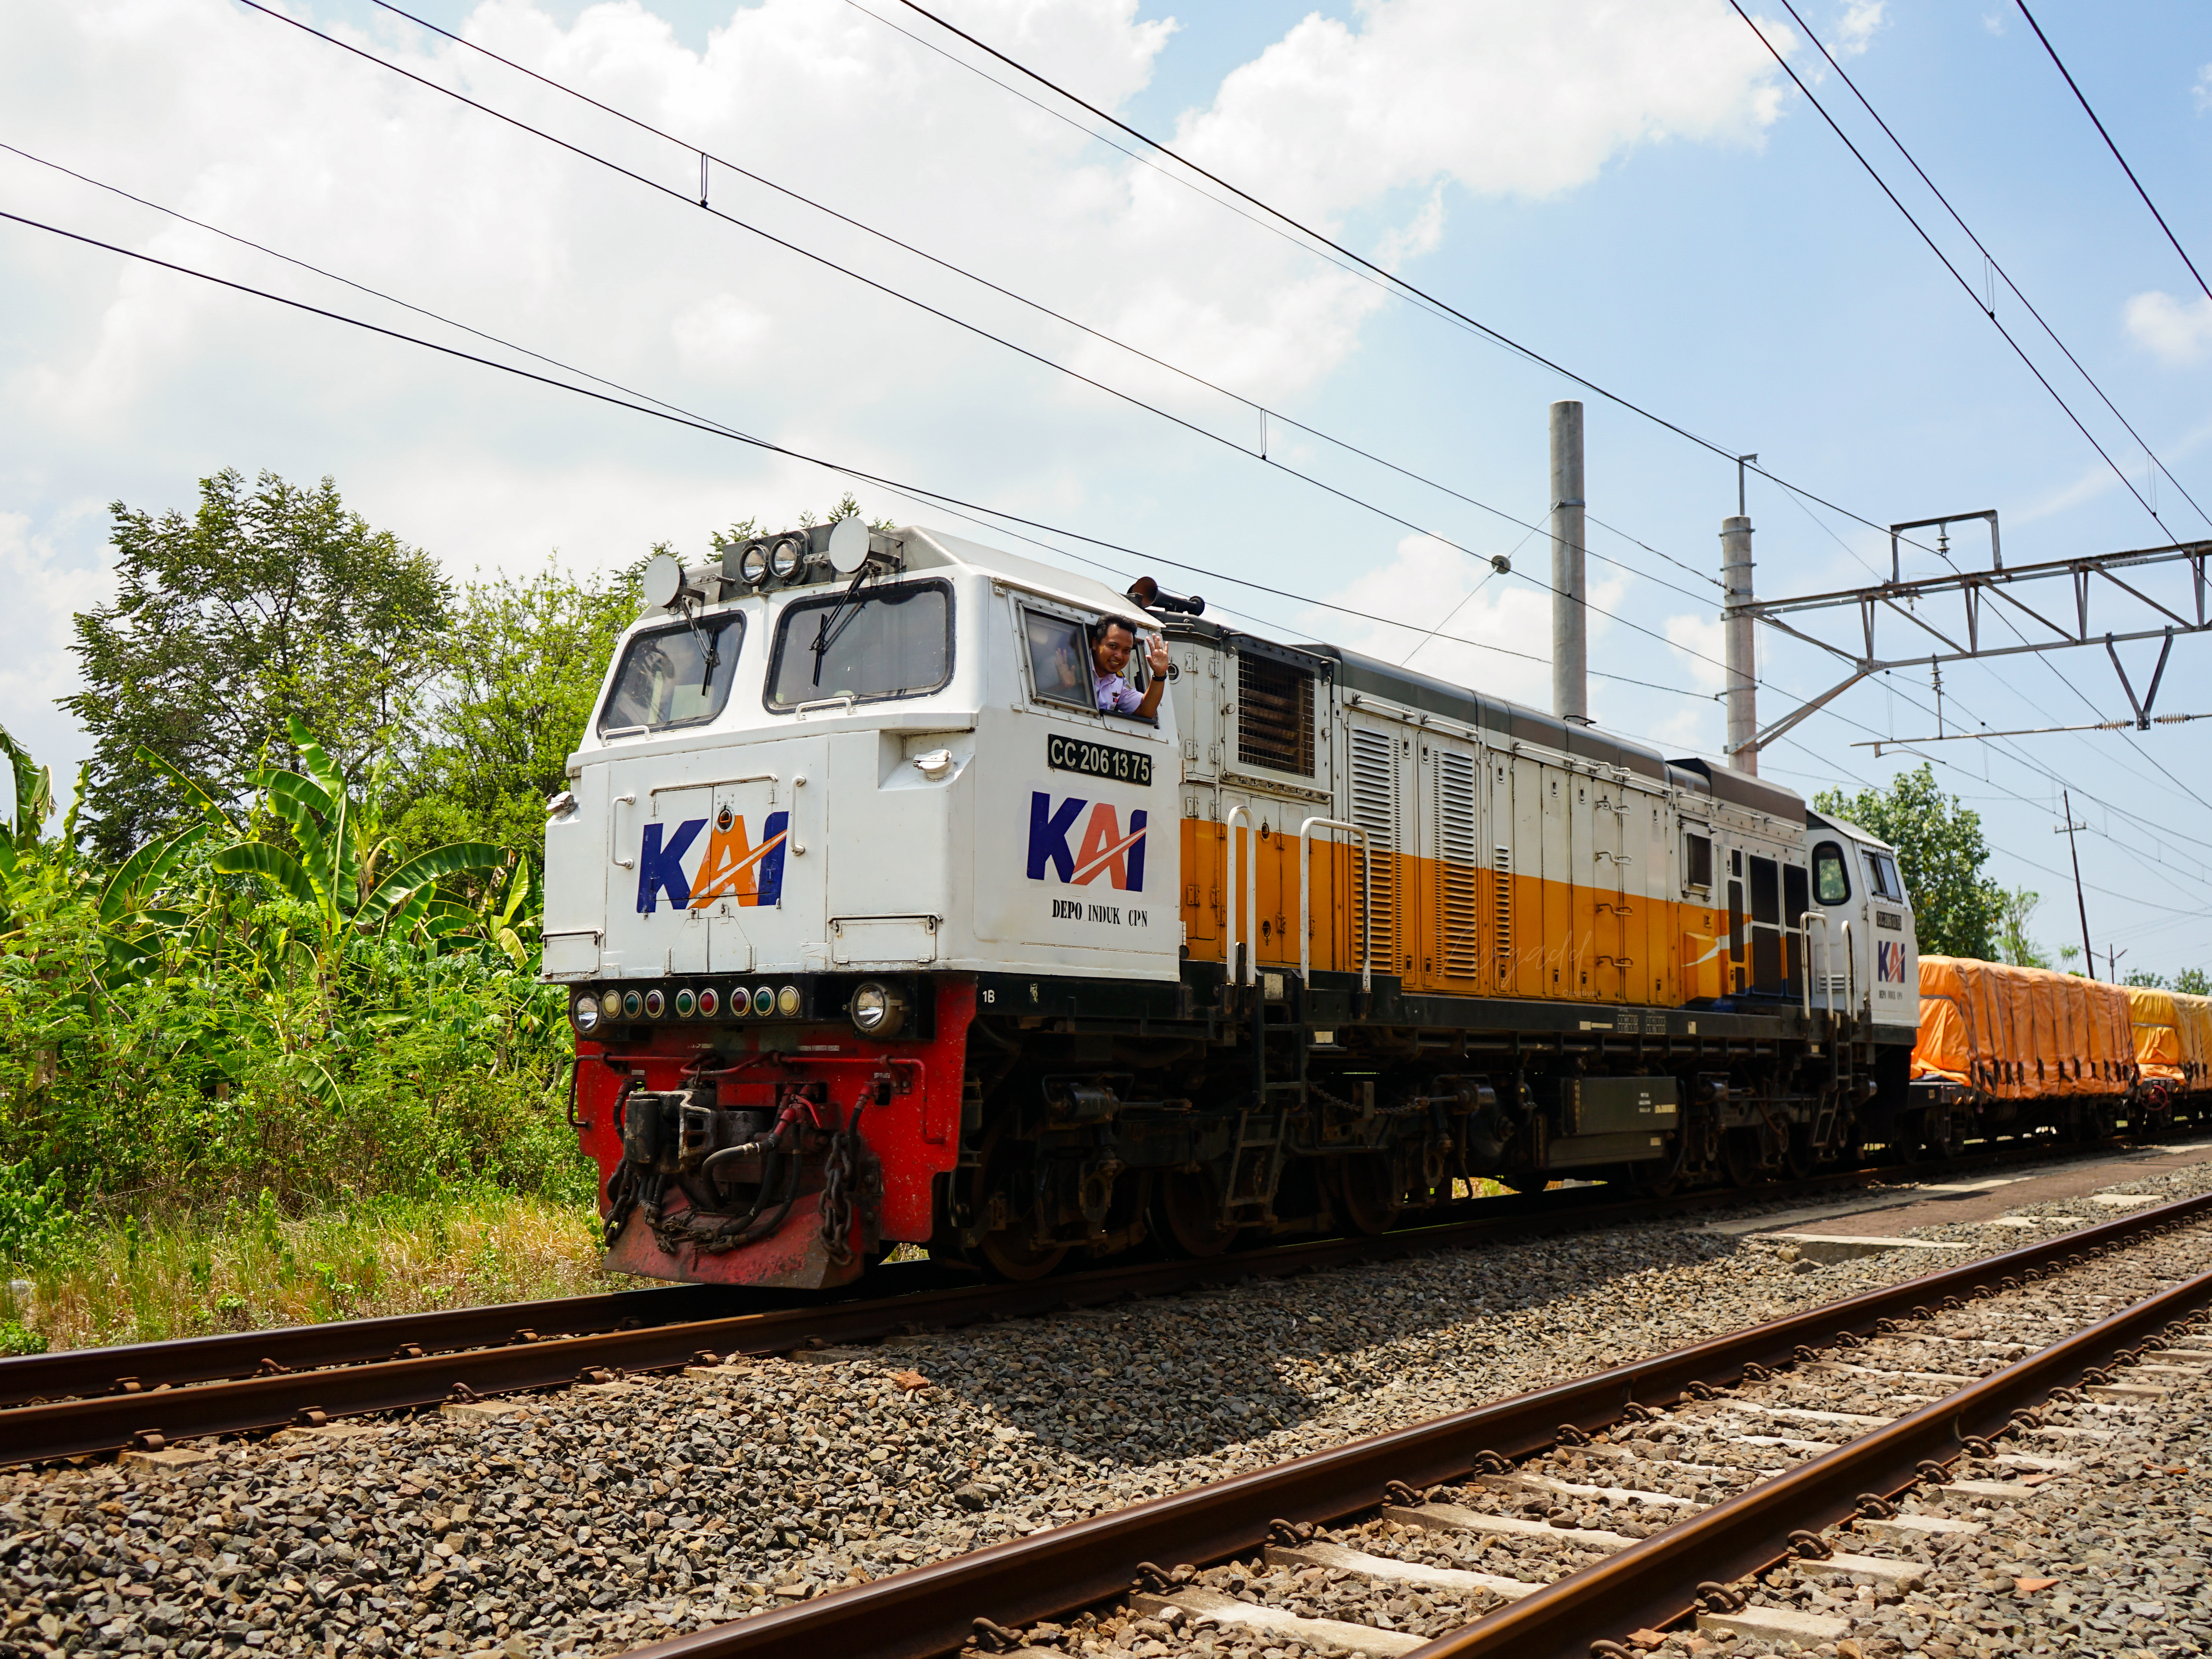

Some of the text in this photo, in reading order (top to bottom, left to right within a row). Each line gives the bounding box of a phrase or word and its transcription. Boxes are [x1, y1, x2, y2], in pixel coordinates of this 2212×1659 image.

[1051, 739, 1150, 781] CC 206 13 75
[637, 811, 789, 914] KAI
[1027, 791, 1147, 893] KAI
[1051, 899, 1147, 927] DEPO INDUK CPN
[1878, 940, 1905, 983] KAI
[982, 989, 995, 1003] 1B
